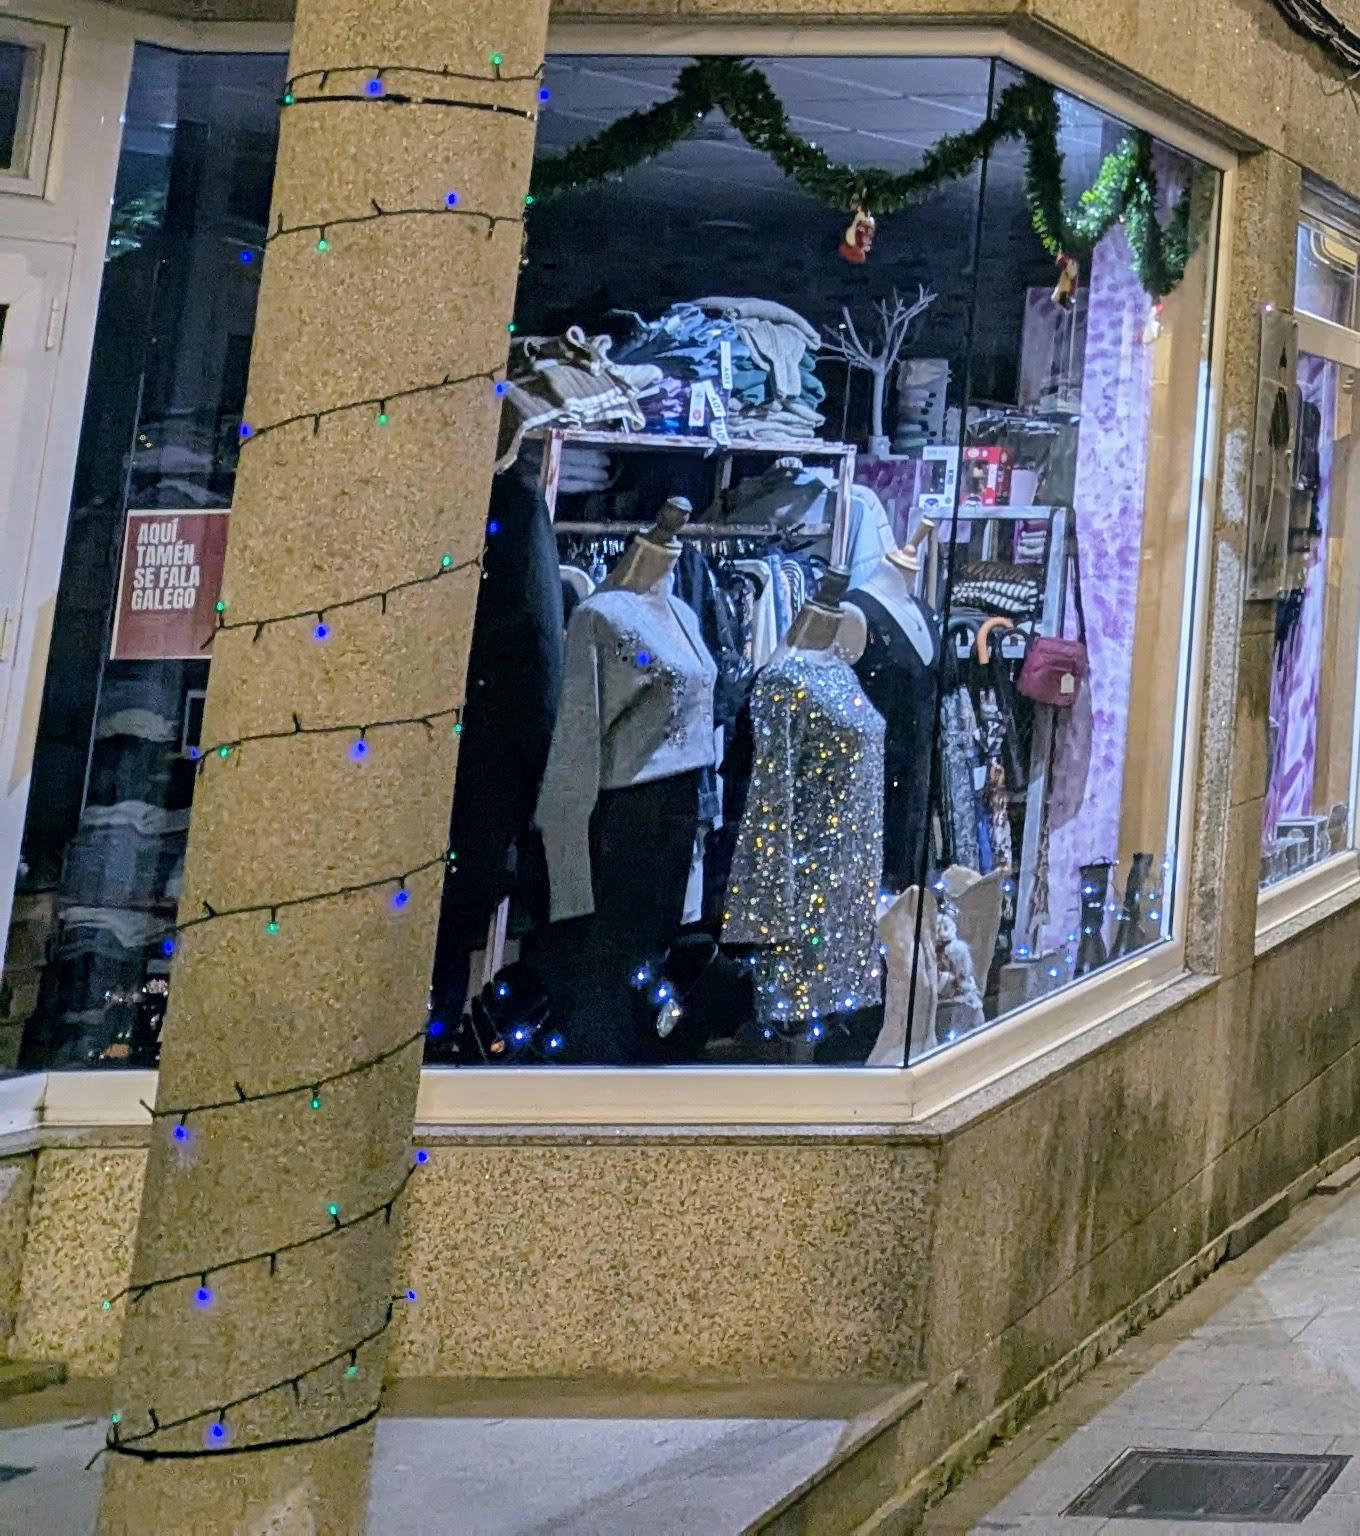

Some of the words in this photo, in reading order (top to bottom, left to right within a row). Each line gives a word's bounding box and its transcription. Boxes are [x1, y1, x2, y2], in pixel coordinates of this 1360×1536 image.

[138, 518, 179, 544] AQUÍ
[136, 541, 195, 567] TAMÉN
[133, 567, 154, 589] SE
[159, 565, 200, 588] FALA
[131, 588, 196, 611] GALEGO
